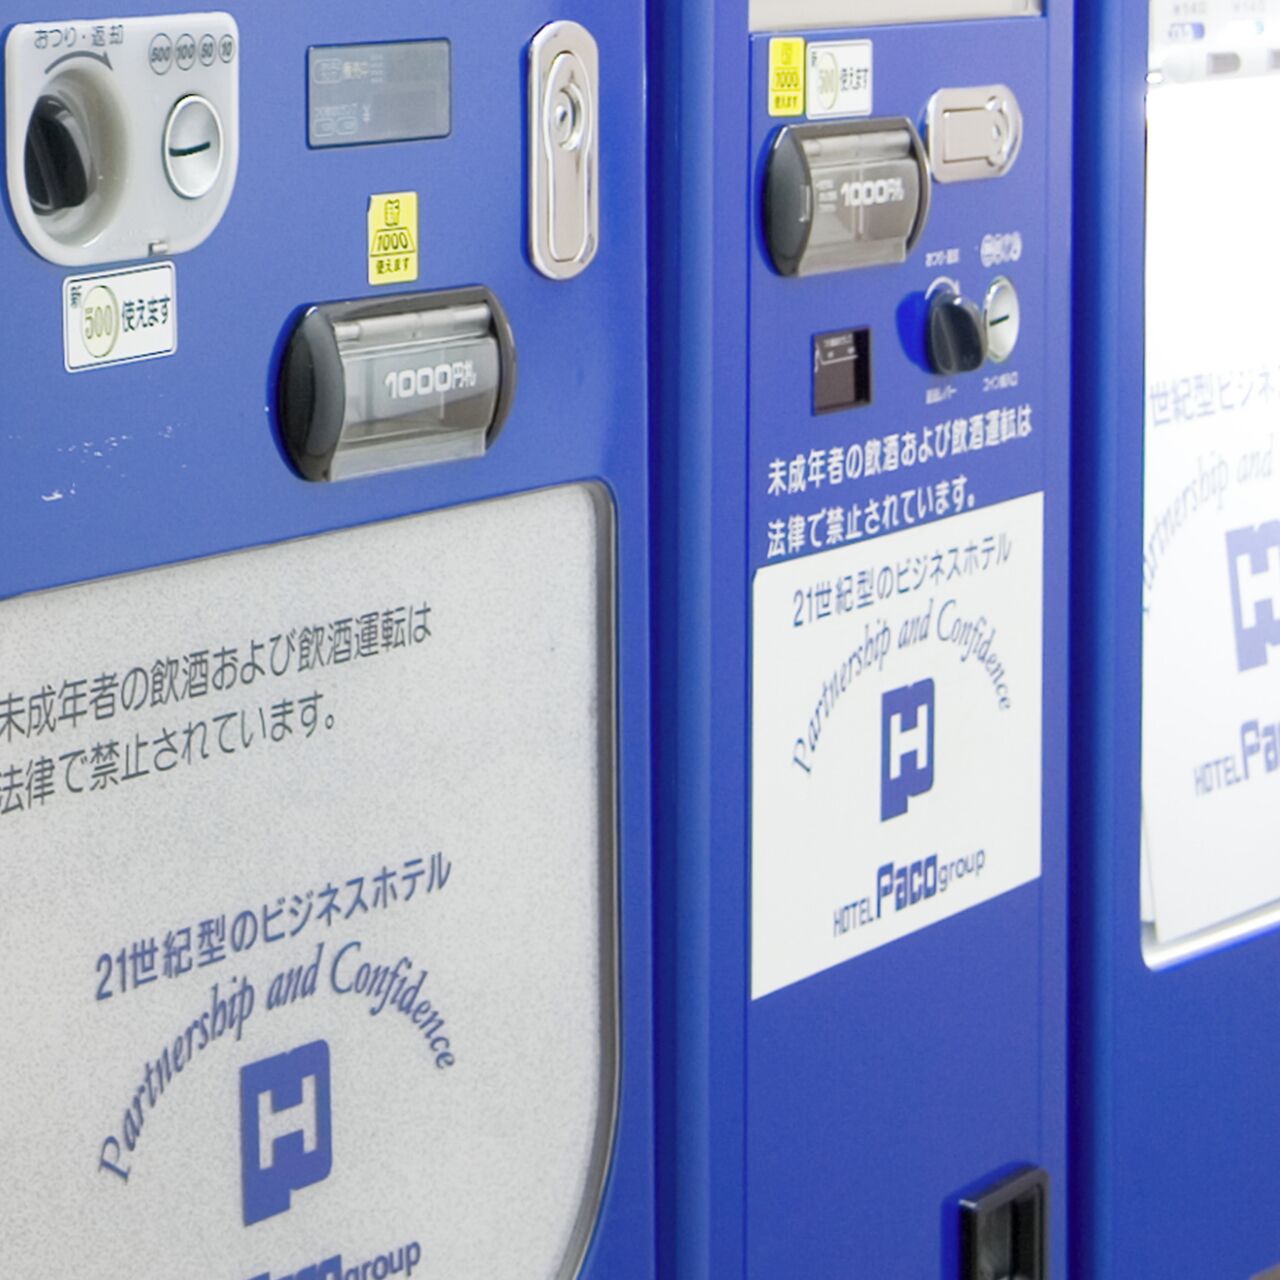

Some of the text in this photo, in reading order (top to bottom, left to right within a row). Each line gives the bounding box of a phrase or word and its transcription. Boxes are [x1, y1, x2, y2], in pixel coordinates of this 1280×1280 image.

[376, 231, 409, 252] 1000
[376, 257, 410, 275] 使えます
[85, 304, 113, 340] 500
[122, 293, 171, 333] 使えます
[767, 404, 1032, 497] 未成年者の飲酒および飲酒運転は
[1236, 433, 1273, 486] and
[767, 475, 976, 560] 法律で禁止されています。
[793, 532, 1013, 628] 21世紀型のビジネスホテル
[792, 598, 1012, 778] Partnership and Confidence
[1193, 753, 1241, 798] HOTEL
[95, 851, 452, 1003] 21世紀型のビジネスホテル
[833, 896, 875, 938] HOTEL
[98, 940, 456, 1187] Partnership and Confidence
